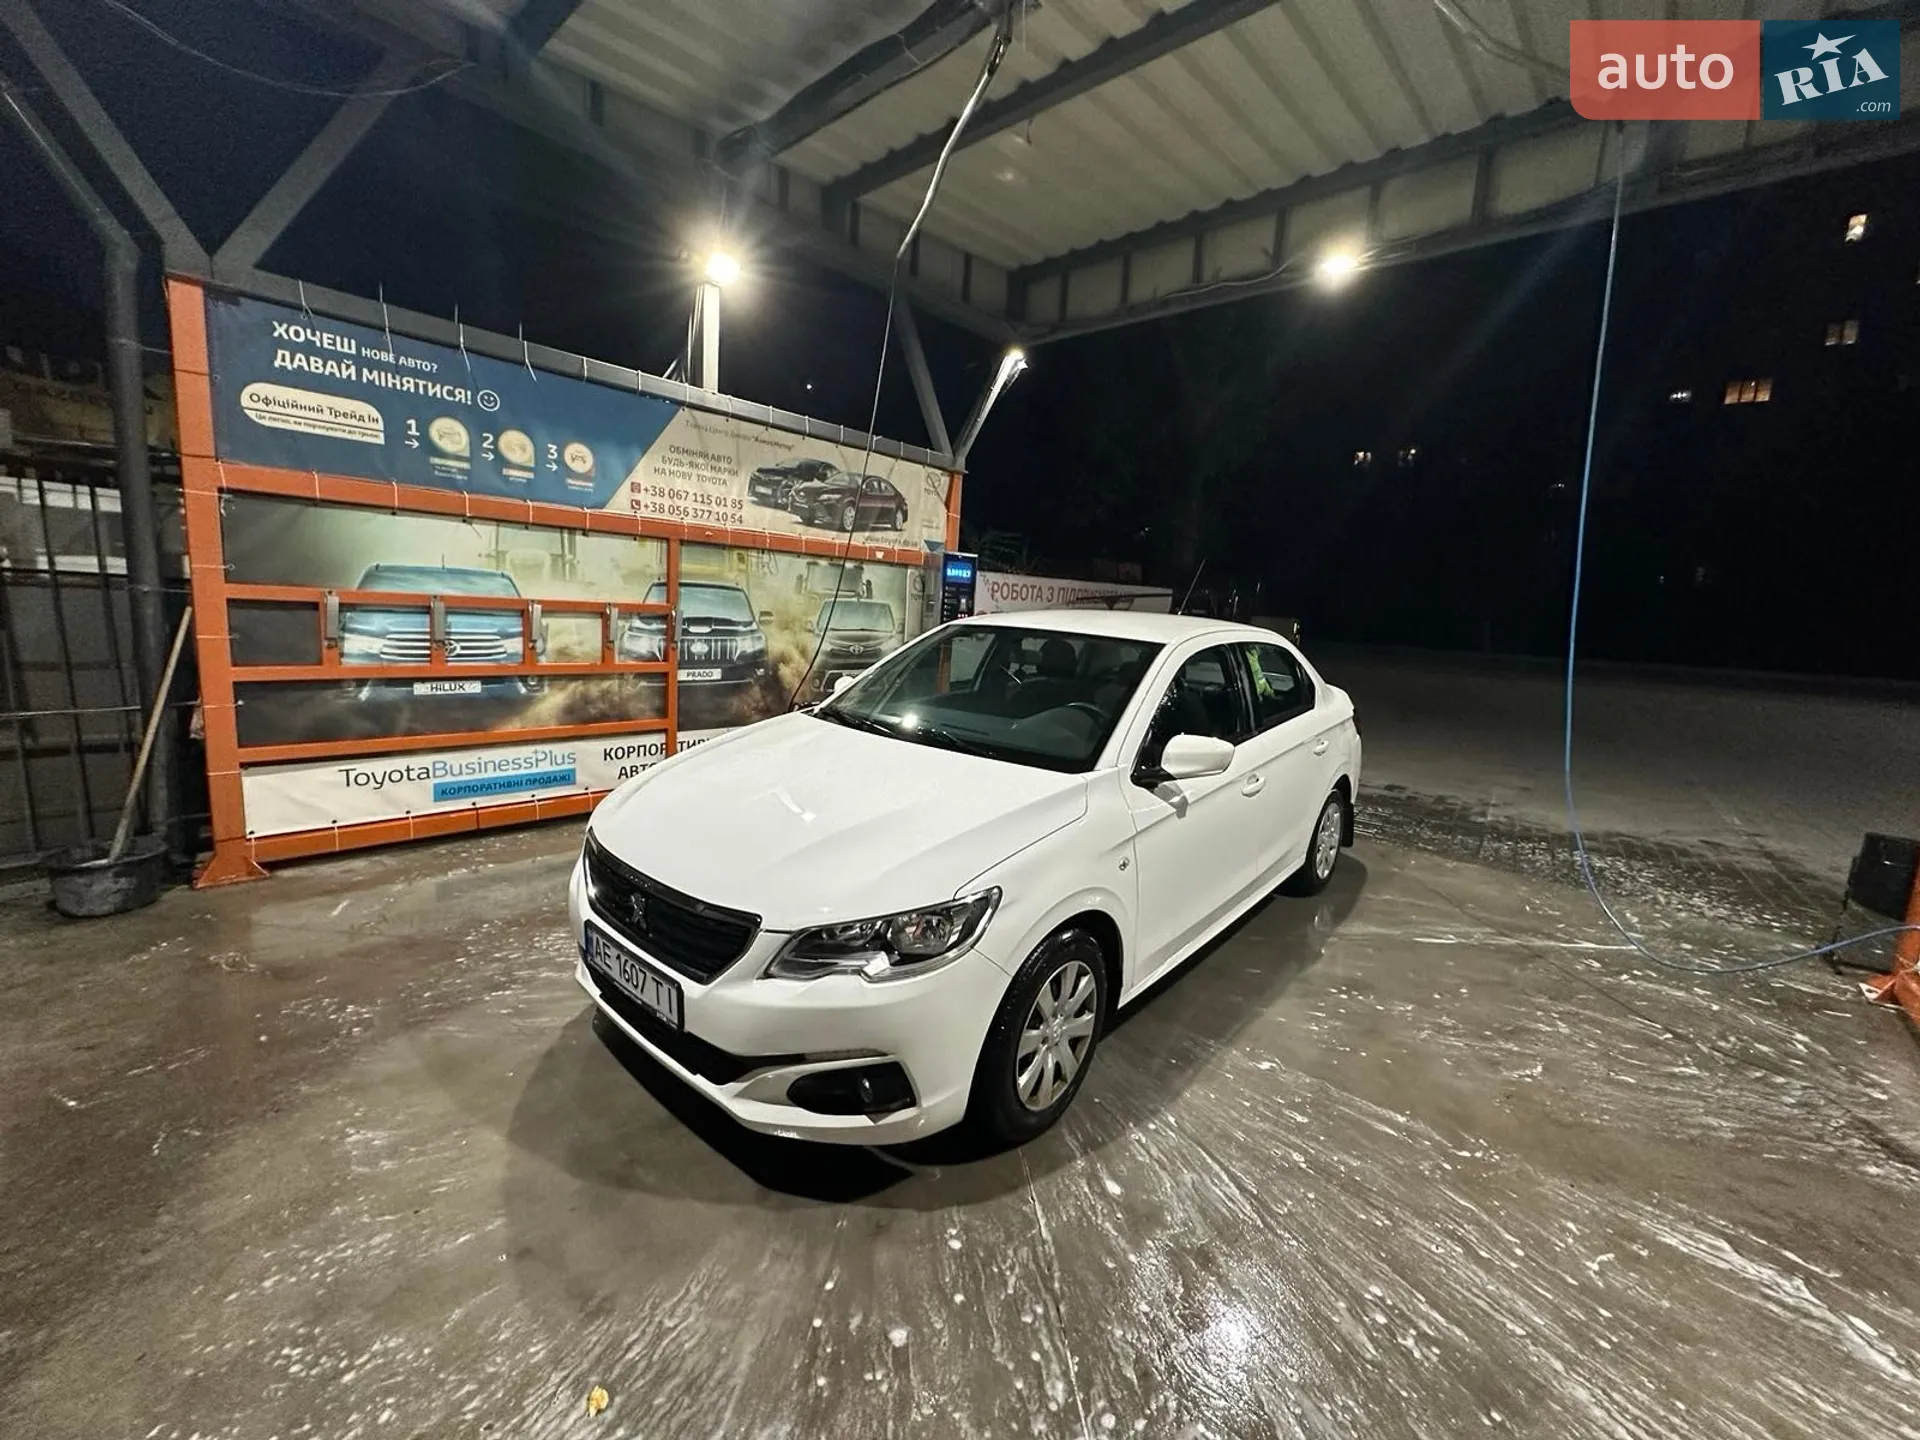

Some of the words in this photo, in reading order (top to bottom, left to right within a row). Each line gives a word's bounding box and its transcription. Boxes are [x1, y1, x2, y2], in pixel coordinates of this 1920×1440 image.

[272, 321, 356, 354] ХОЧЕШ
[361, 347, 396, 363] НОВЕ
[399, 355, 438, 373] АВТО?
[274, 349, 356, 381] ДАВАЙ
[362, 368, 472, 404] МІНЯТИСЯ!
[249, 393, 324, 414] Офіційний
[326, 407, 366, 422] Трейд
[406, 419, 420, 436] 1
[482, 433, 495, 449] 2
[547, 444, 558, 459] 3
[669, 444, 711, 461] ОБМІНЯЙ
[710, 453, 733, 465] АВТО
[653, 466, 667, 477] НА
[668, 470, 693, 481] НОВУ
[696, 473, 728, 486] TOYOTA
[643, 484, 666, 499] +38
[668, 488, 689, 501] 067
[693, 493, 713, 506] 115
[715, 496, 728, 507] 01
[643, 501, 666, 514] +38
[668, 504, 690, 517] 056
[692, 508, 713, 520] 377
[715, 512, 729, 522] 10
[731, 514, 743, 524] 54
[991, 582, 1044, 602] РОБОТА
[430, 683, 466, 692] HILUX
[617, 762, 658, 779] АВТ
[441, 779, 523, 796] КОРПОРАТИВНІ
[525, 774, 571, 786] ПРОДАЖІ
[594, 937, 612, 970] AE
[615, 953, 647, 995] 1607
[651, 976, 673, 1015] TI
